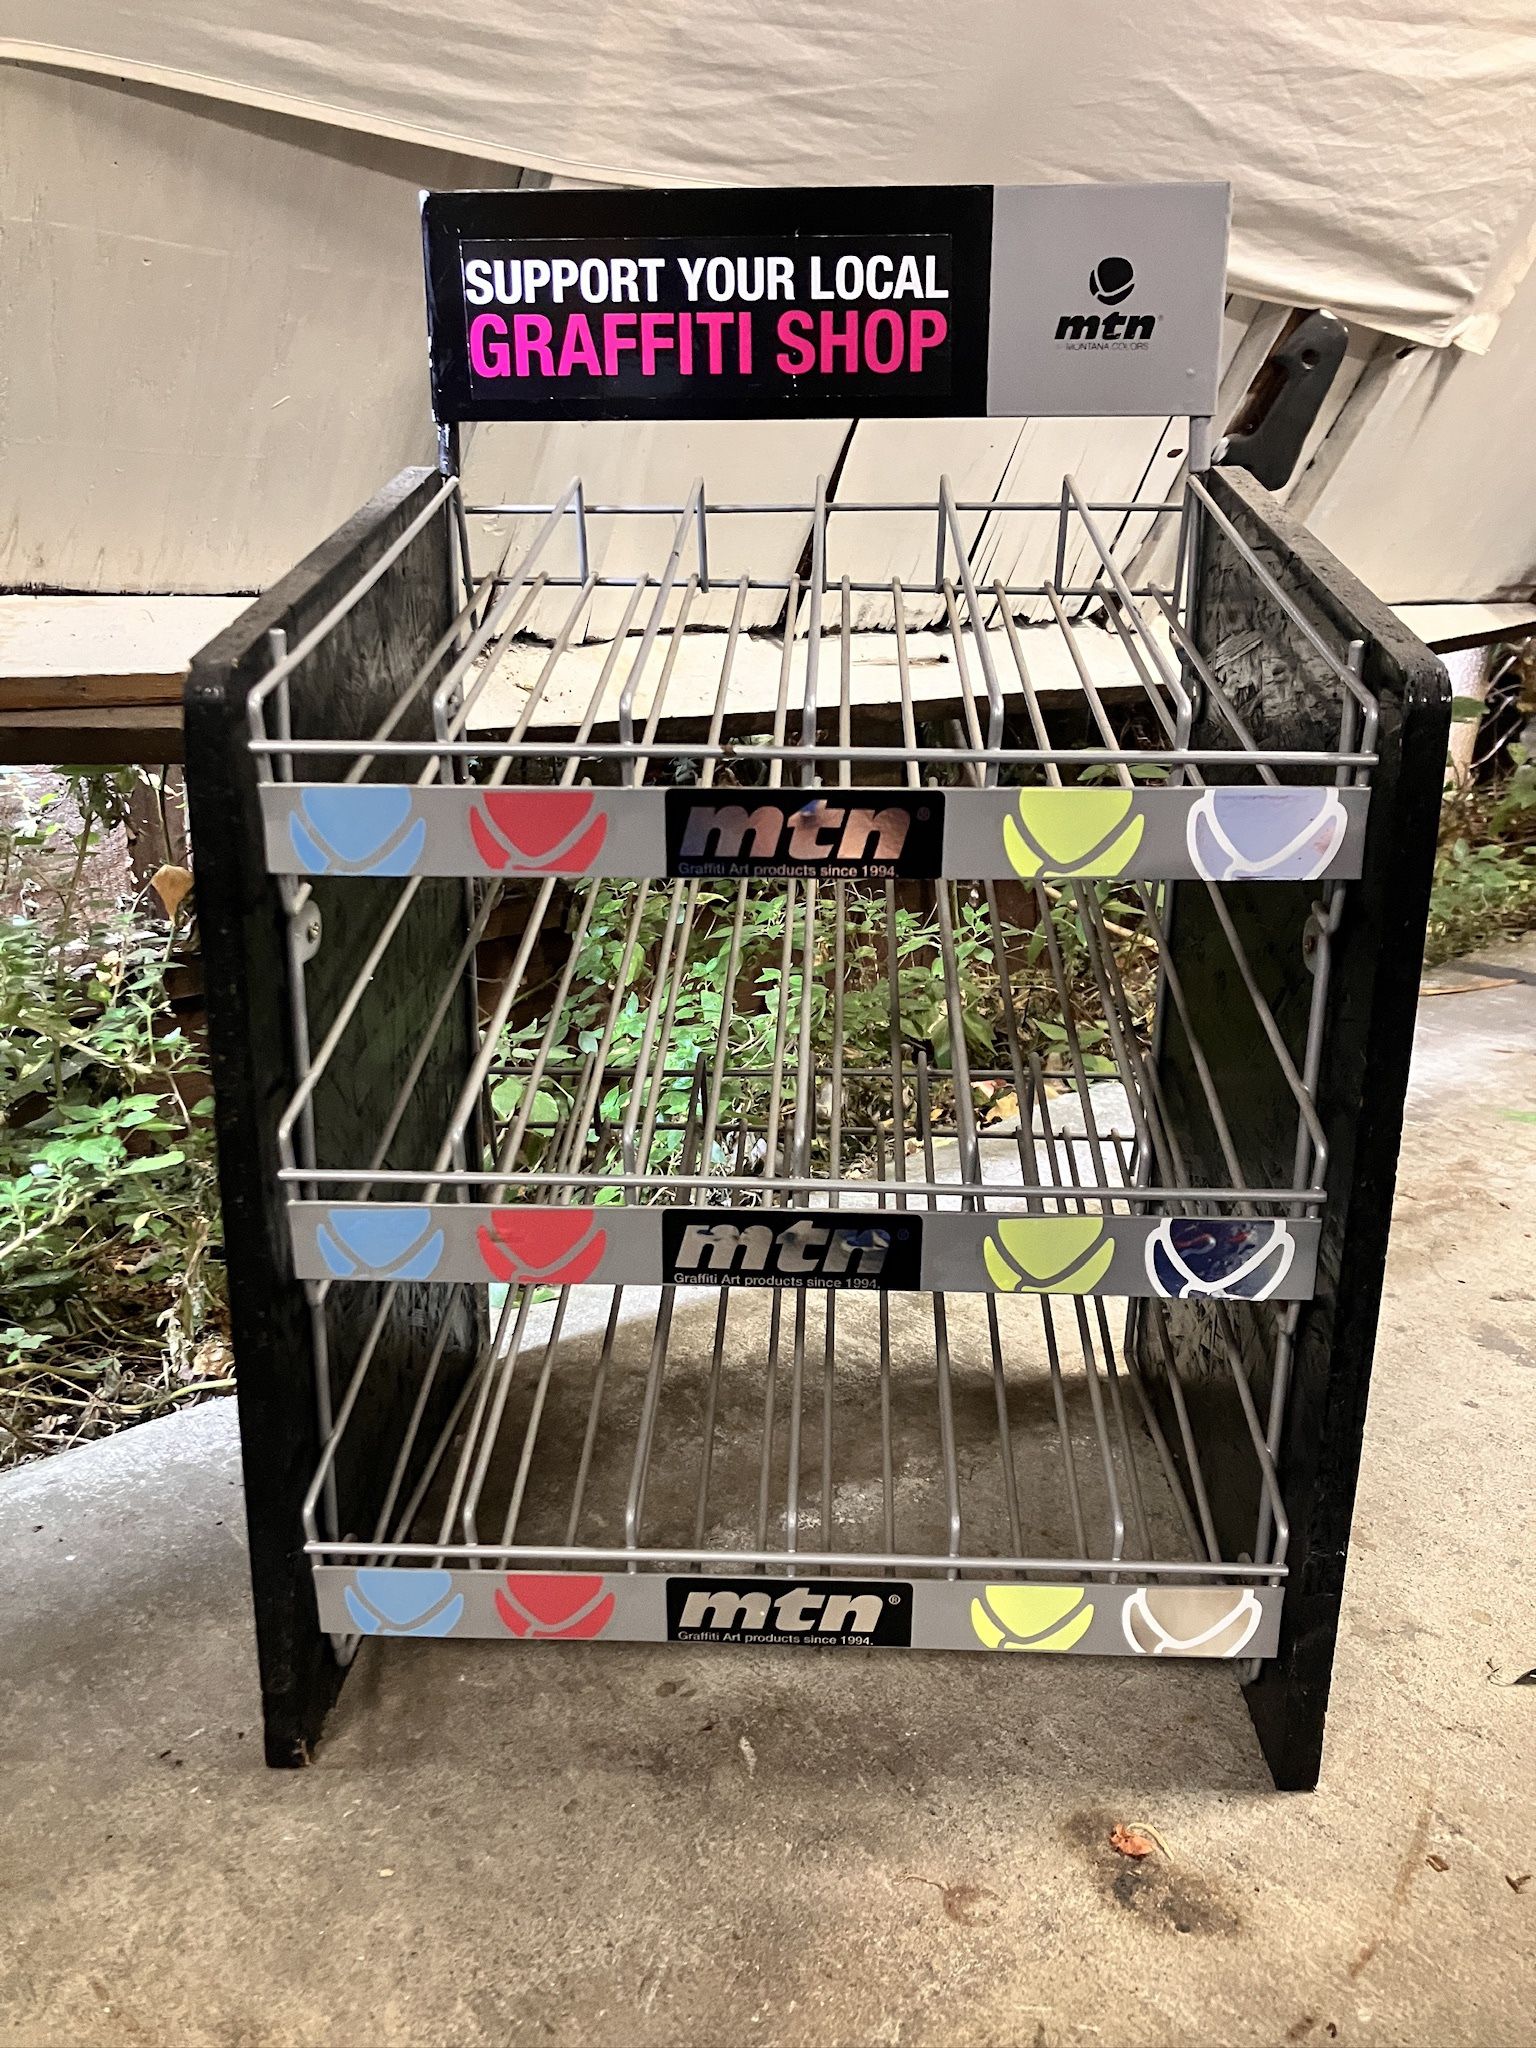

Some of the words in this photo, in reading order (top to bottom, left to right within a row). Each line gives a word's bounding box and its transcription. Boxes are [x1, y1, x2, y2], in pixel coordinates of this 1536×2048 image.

[465, 258, 665, 305] SUPPORT
[678, 256, 795, 302] YOUR
[810, 254, 949, 300] LOCAL
[469, 311, 752, 378] GRAFFITI
[776, 308, 948, 376] SHOP
[1066, 342, 1109, 351] MONTANA
[678, 862, 726, 876] Graffiti
[729, 863, 749, 876] Art
[753, 863, 816, 878] products
[820, 864, 858, 877] since
[861, 865, 900, 878] 1994.
[673, 1272, 718, 1285] Graffiti
[721, 1274, 741, 1286] Art
[744, 1275, 803, 1288] products
[806, 1276, 842, 1289] since
[845, 1277, 881, 1290] 1994.
[677, 1631, 720, 1641] Graffiti
[723, 1632, 742, 1642] Art
[744, 1633, 801, 1645] products
[803, 1635, 837, 1645] since
[840, 1635, 874, 1646] 1994.
